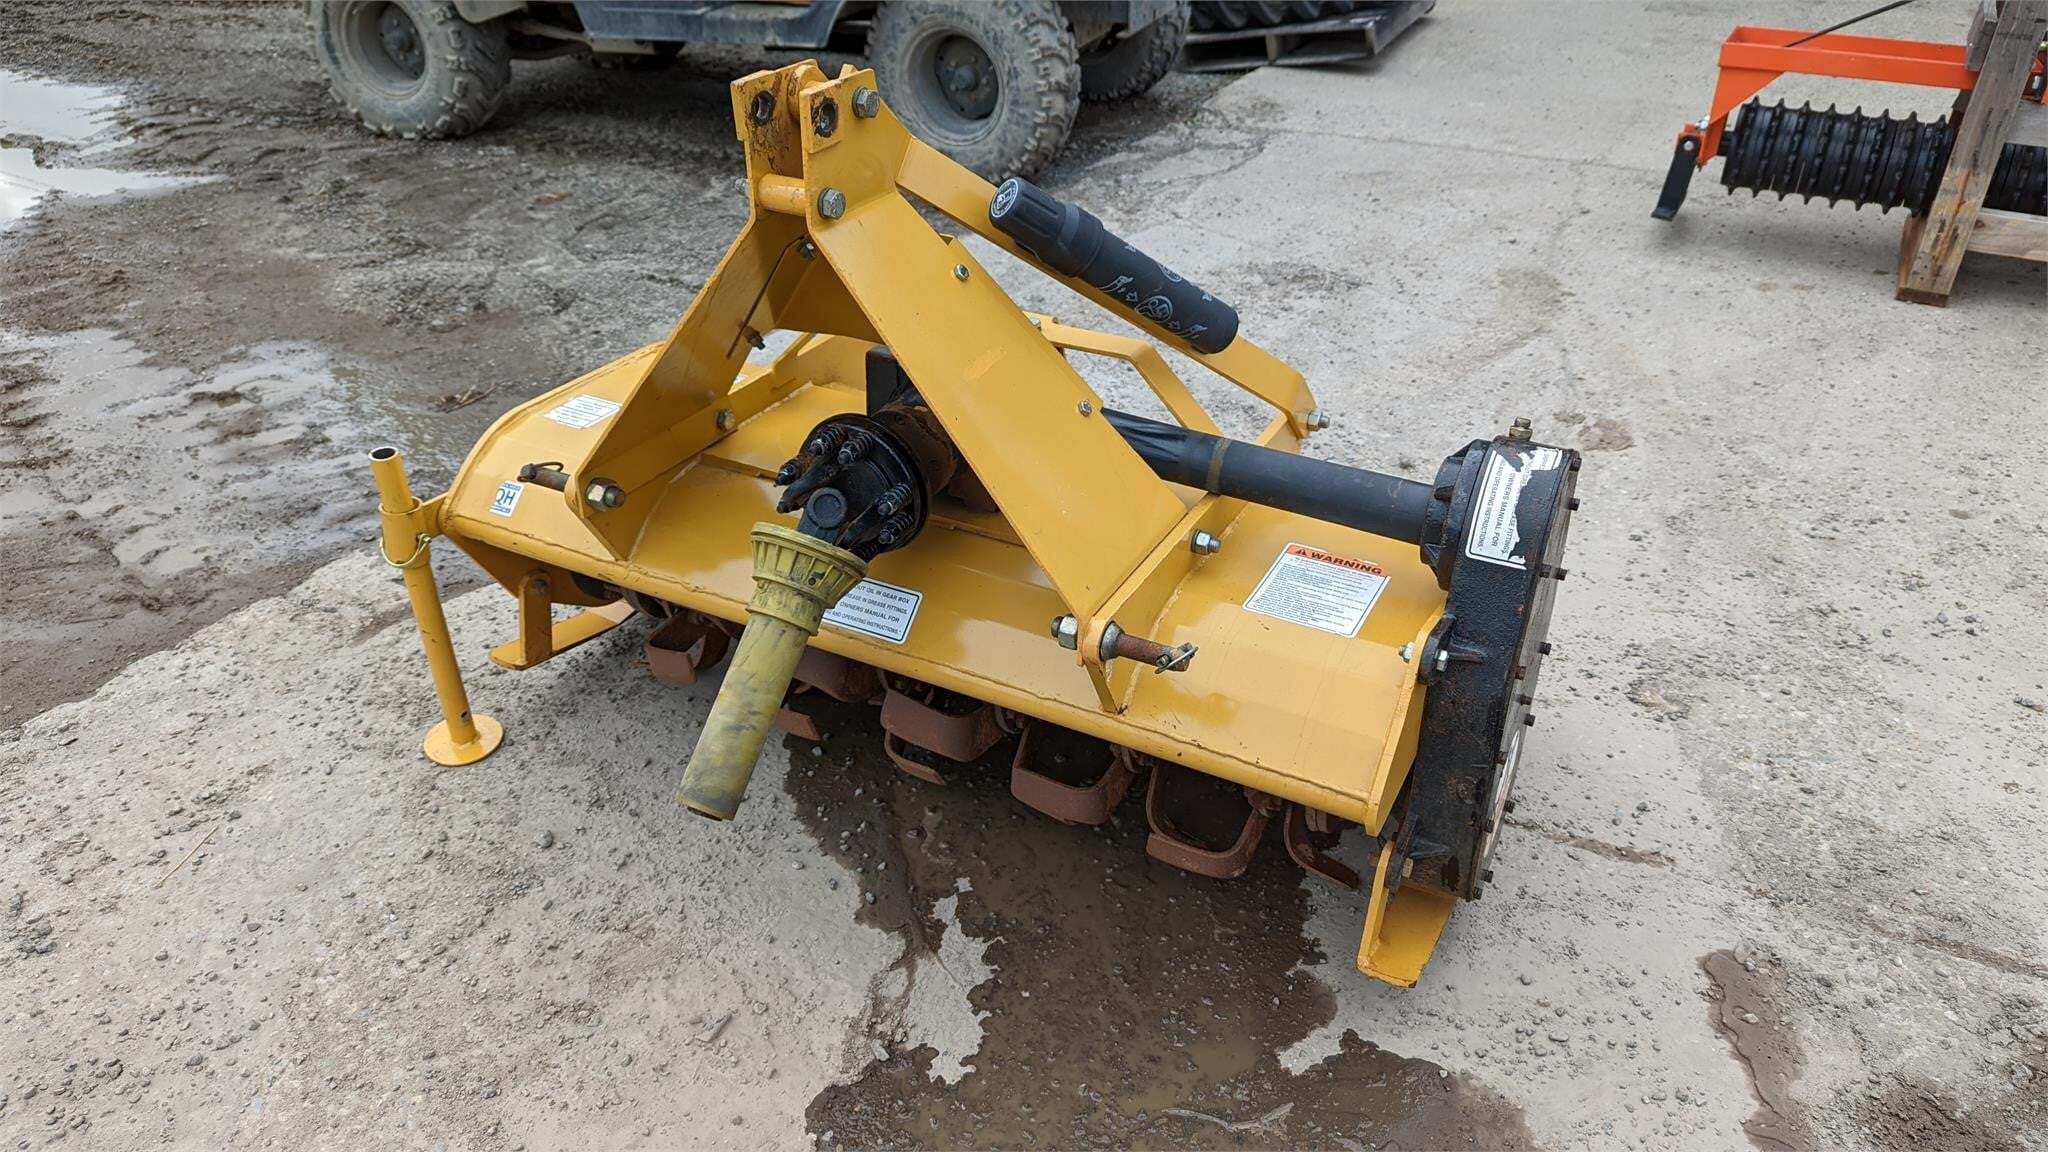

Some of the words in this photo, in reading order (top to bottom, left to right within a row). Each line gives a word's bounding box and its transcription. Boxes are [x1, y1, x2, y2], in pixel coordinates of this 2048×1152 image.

[1495, 501, 1508, 530] MANUAL
[1491, 531, 1500, 546] FOR
[1311, 551, 1382, 575] WARNING
[868, 598, 887, 608] GREASE
[882, 591, 898, 600] GEAR
[840, 600, 864, 612] OWNERS
[864, 607, 888, 619] MANUAL
[888, 614, 900, 623] FOR
